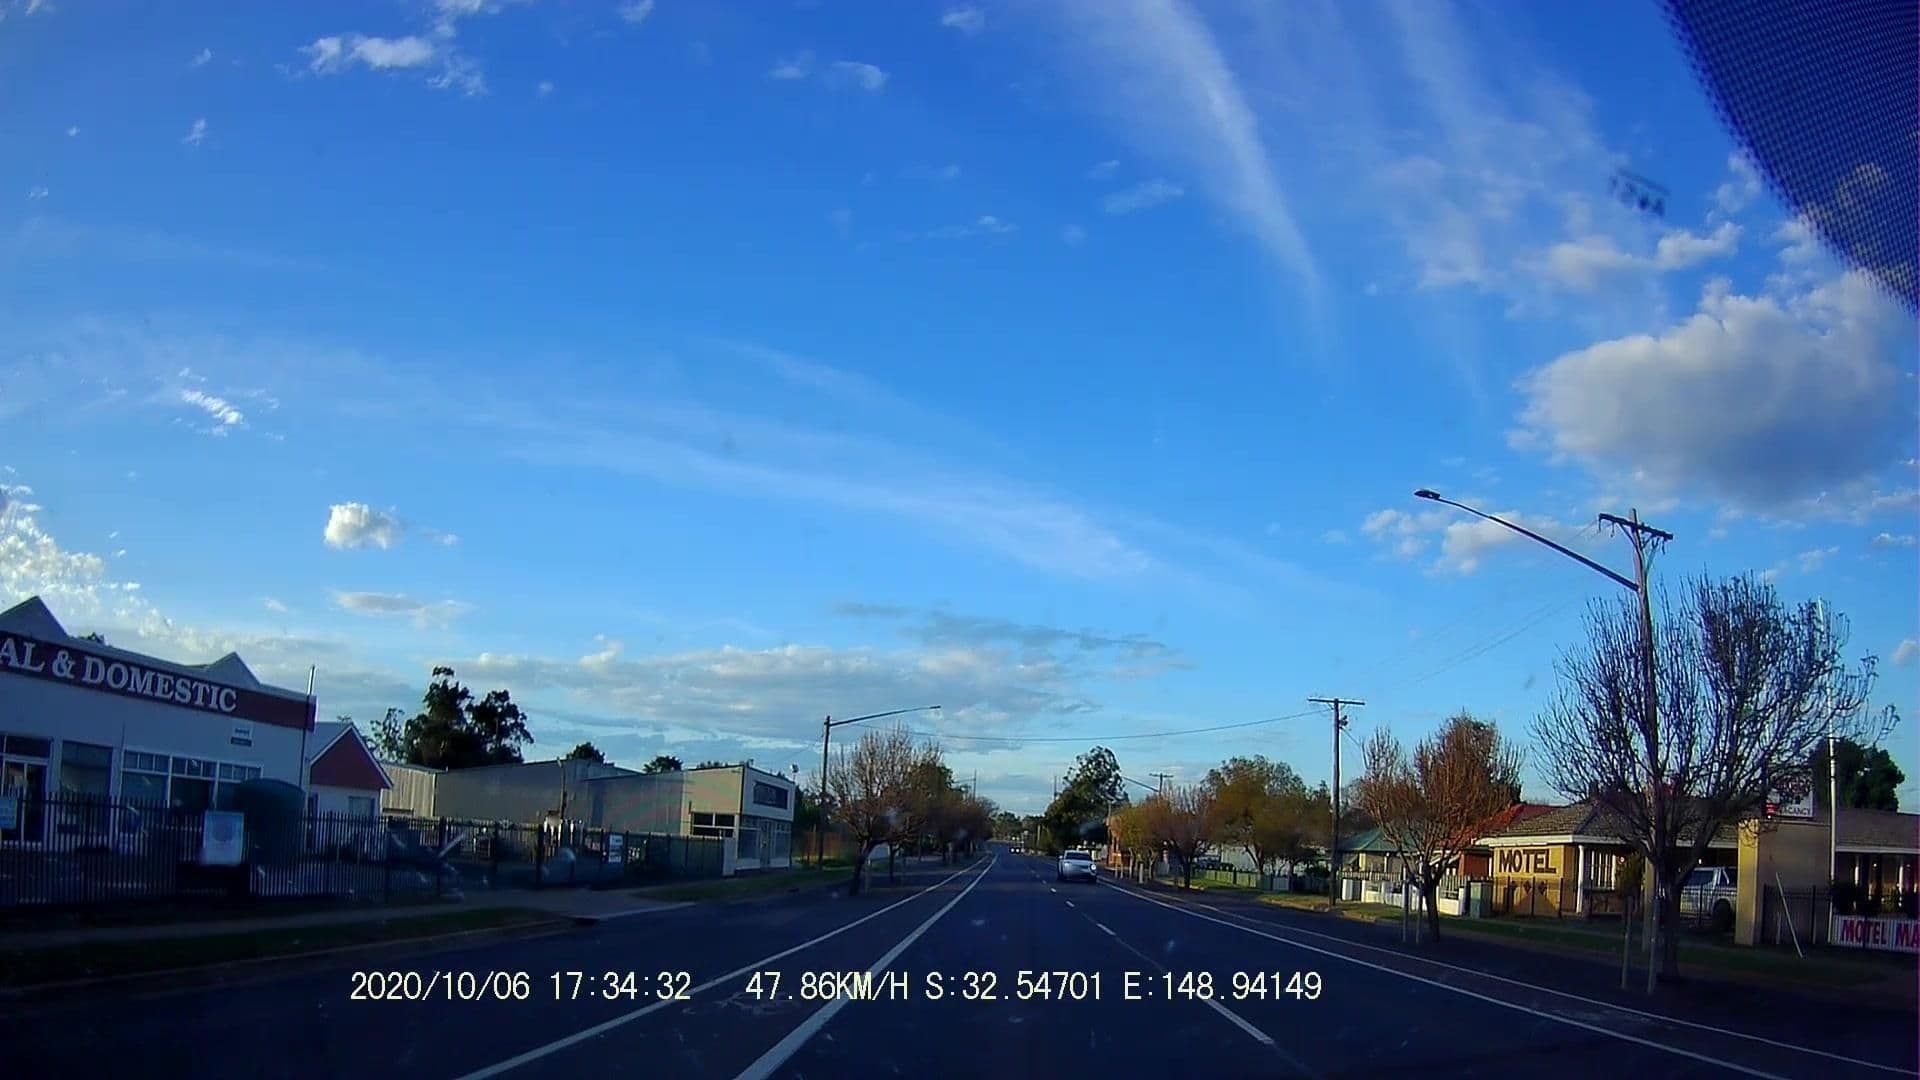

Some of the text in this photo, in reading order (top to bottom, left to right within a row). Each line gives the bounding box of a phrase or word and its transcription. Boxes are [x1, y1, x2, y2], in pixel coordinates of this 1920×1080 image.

[52, 649, 76, 679] &
[82, 655, 237, 712] DOMESTIC
[1499, 848, 1557, 873] MOTEL
[1841, 919, 1887, 945] MOTEL
